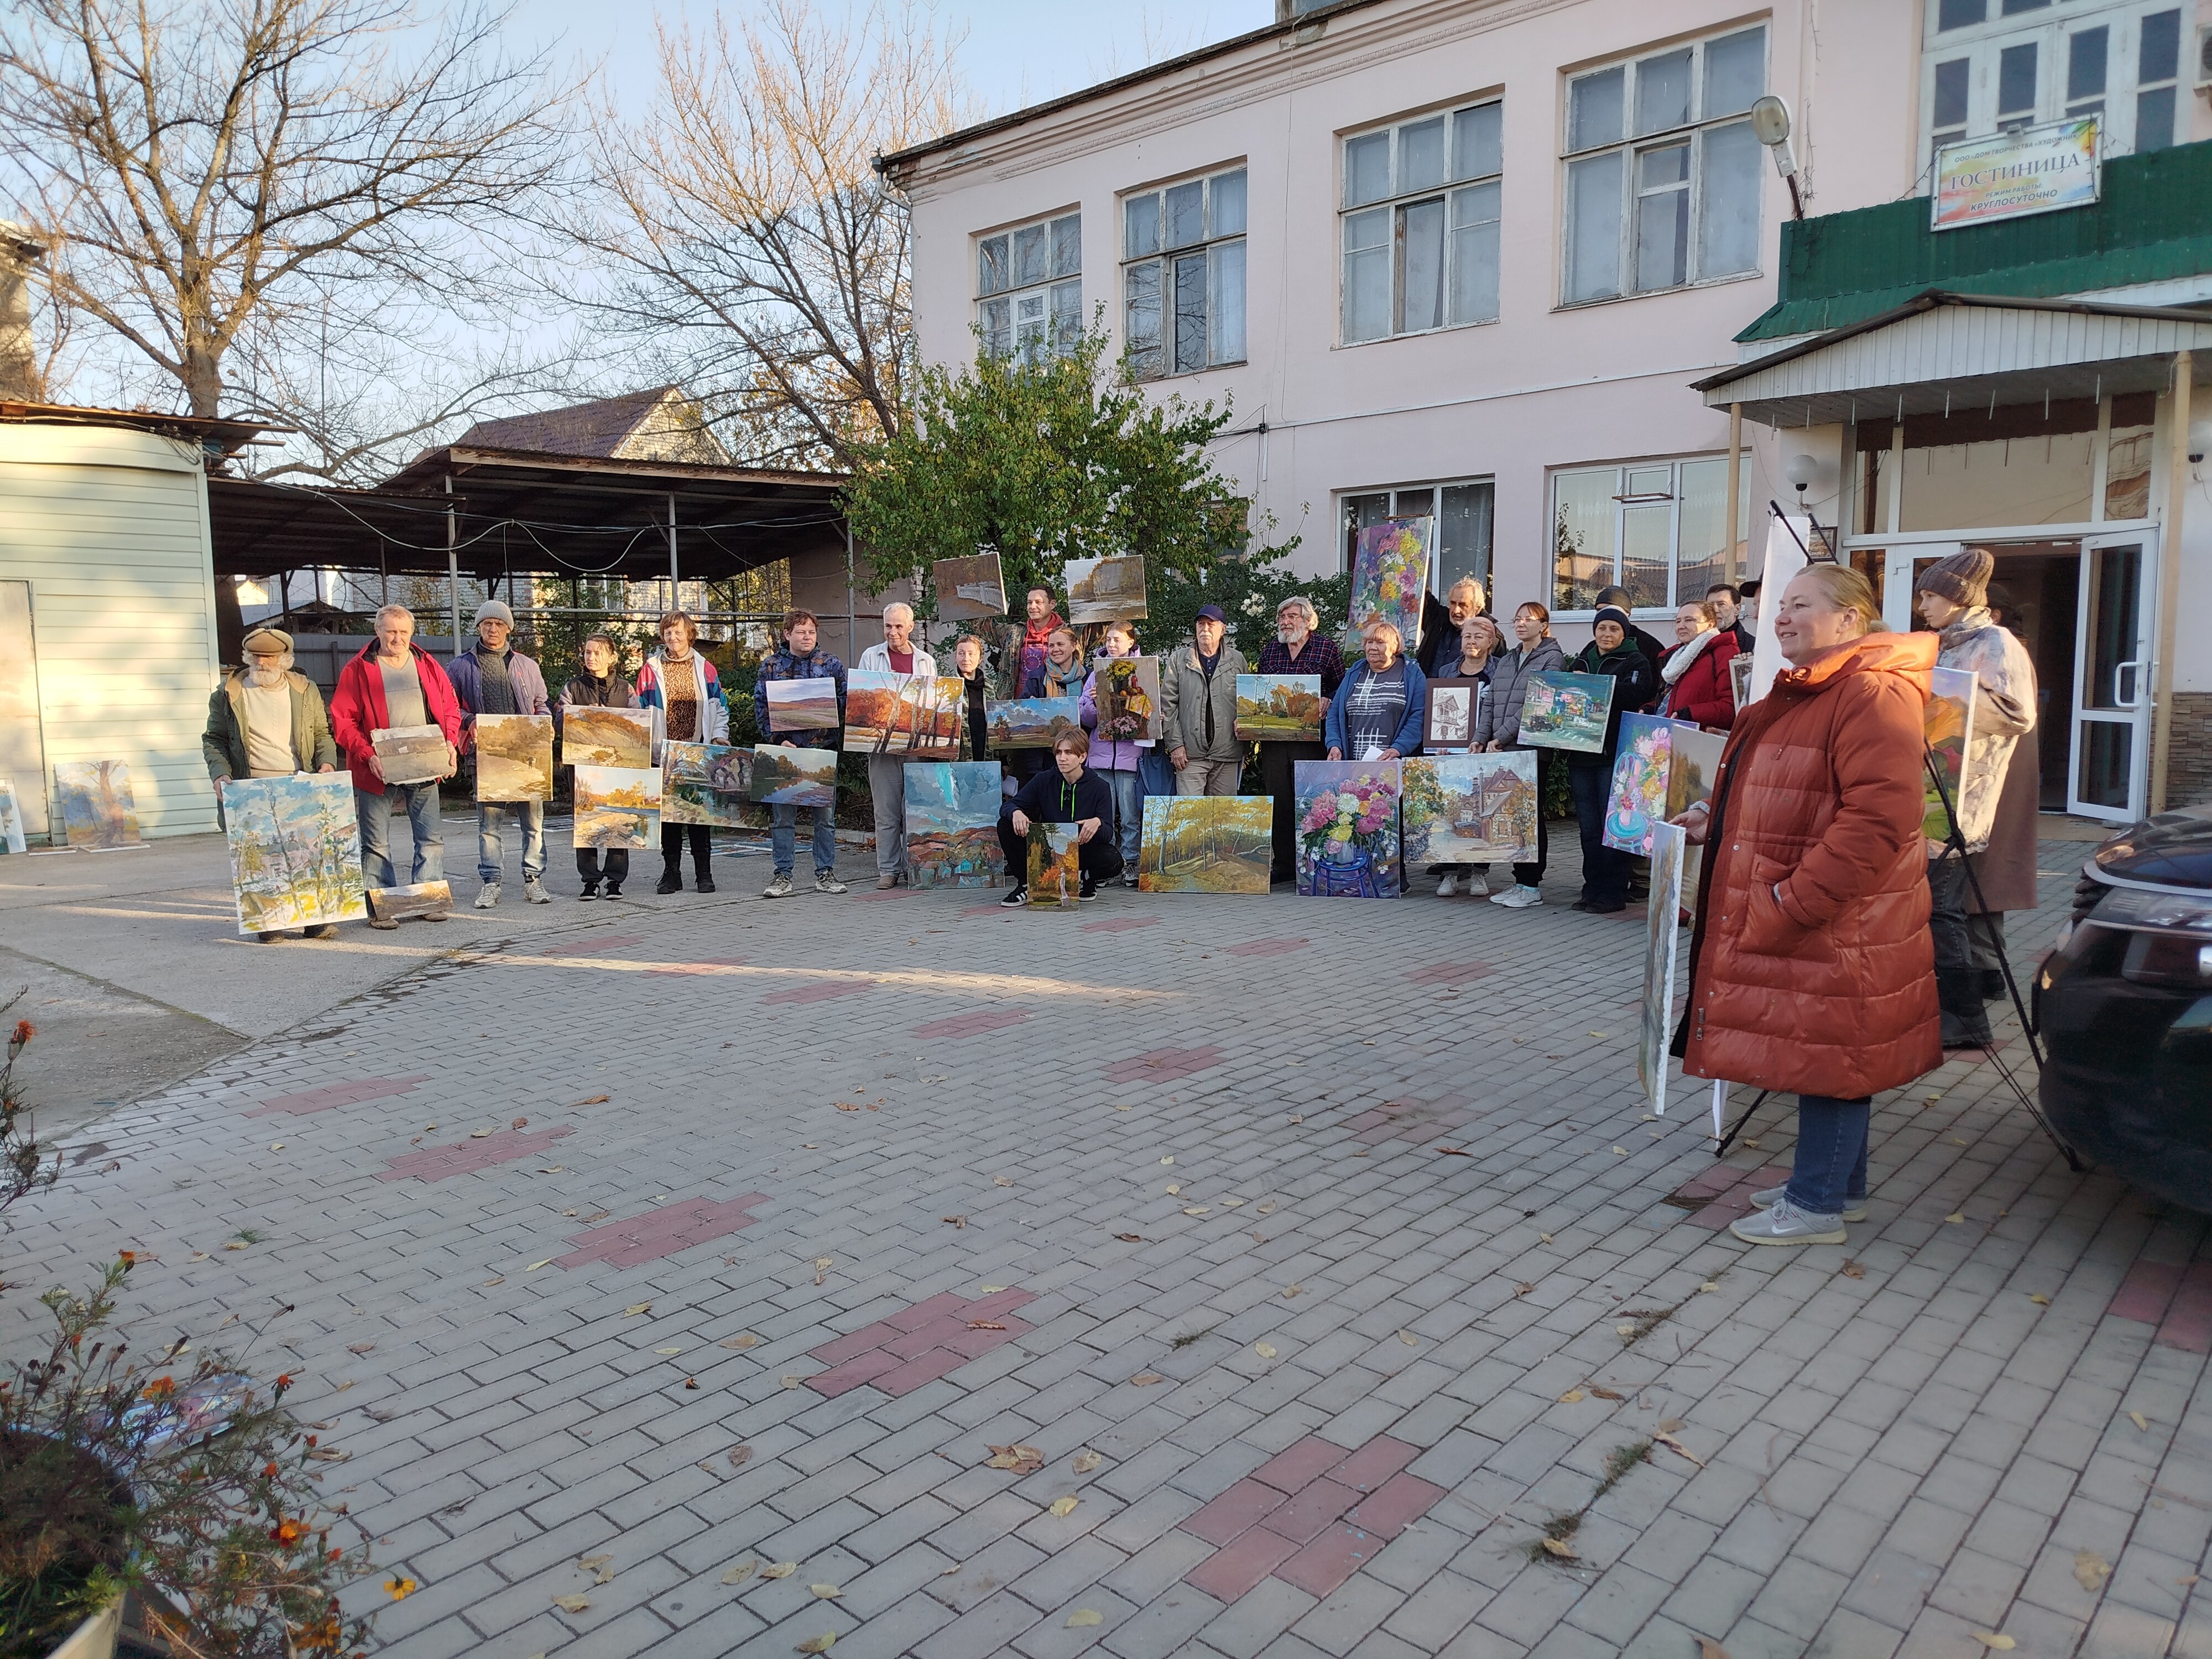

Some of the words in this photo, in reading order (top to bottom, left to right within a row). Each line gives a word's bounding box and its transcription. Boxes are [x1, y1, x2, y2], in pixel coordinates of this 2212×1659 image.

[1971, 150, 1990, 160] «ДОМ
[1991, 142, 2033, 155] ТВОРЧЕСТВА
[1950, 153, 2080, 190] ГОСТИНИЦА
[1970, 189, 2058, 212] КРУГЛОСУТОЧНО
[1985, 189, 2011, 199] РЕЖИМ
[2012, 182, 2043, 194] РАБОТЫ:
